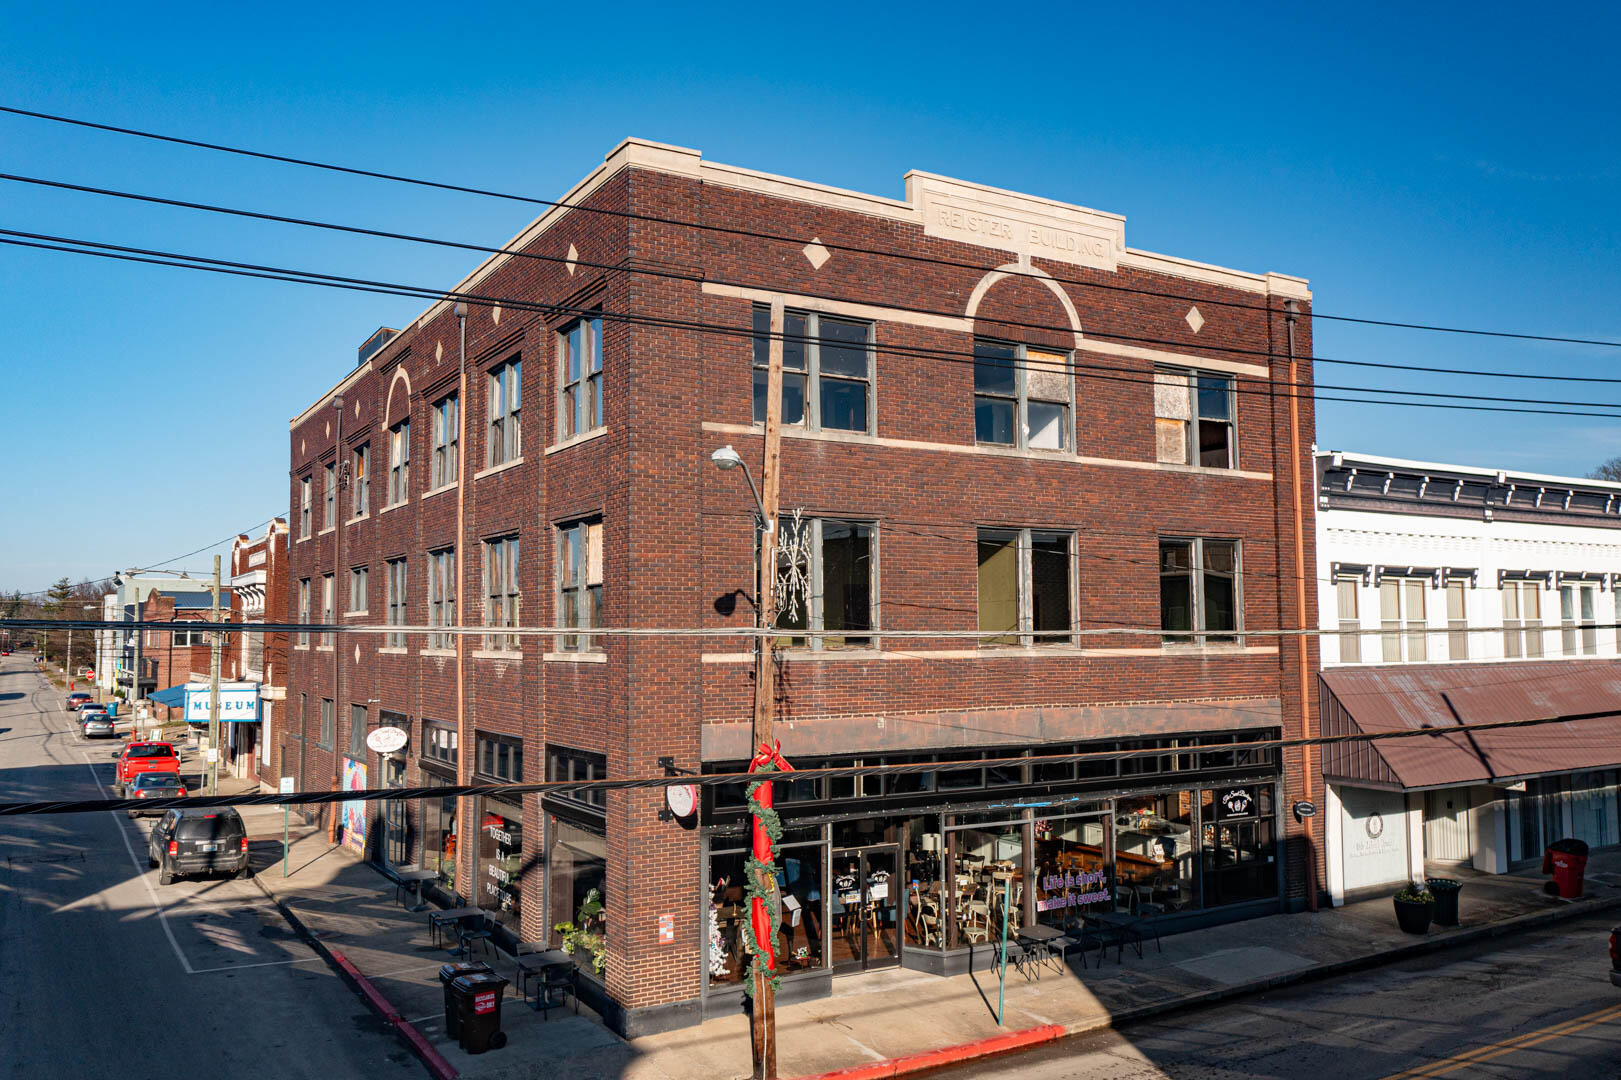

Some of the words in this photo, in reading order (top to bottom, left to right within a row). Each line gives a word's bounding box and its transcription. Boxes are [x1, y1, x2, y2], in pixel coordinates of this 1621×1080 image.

[938, 209, 1013, 240] REISTER
[1028, 227, 1104, 258] BUILDING
[193, 701, 255, 710] MUEUM
[490, 826, 512, 846] TOGETHER
[1043, 874, 1064, 891] Life
[1065, 872, 1075, 888] is
[1076, 869, 1107, 886] short,
[1037, 895, 1067, 912] make
[1067, 892, 1077, 907] it
